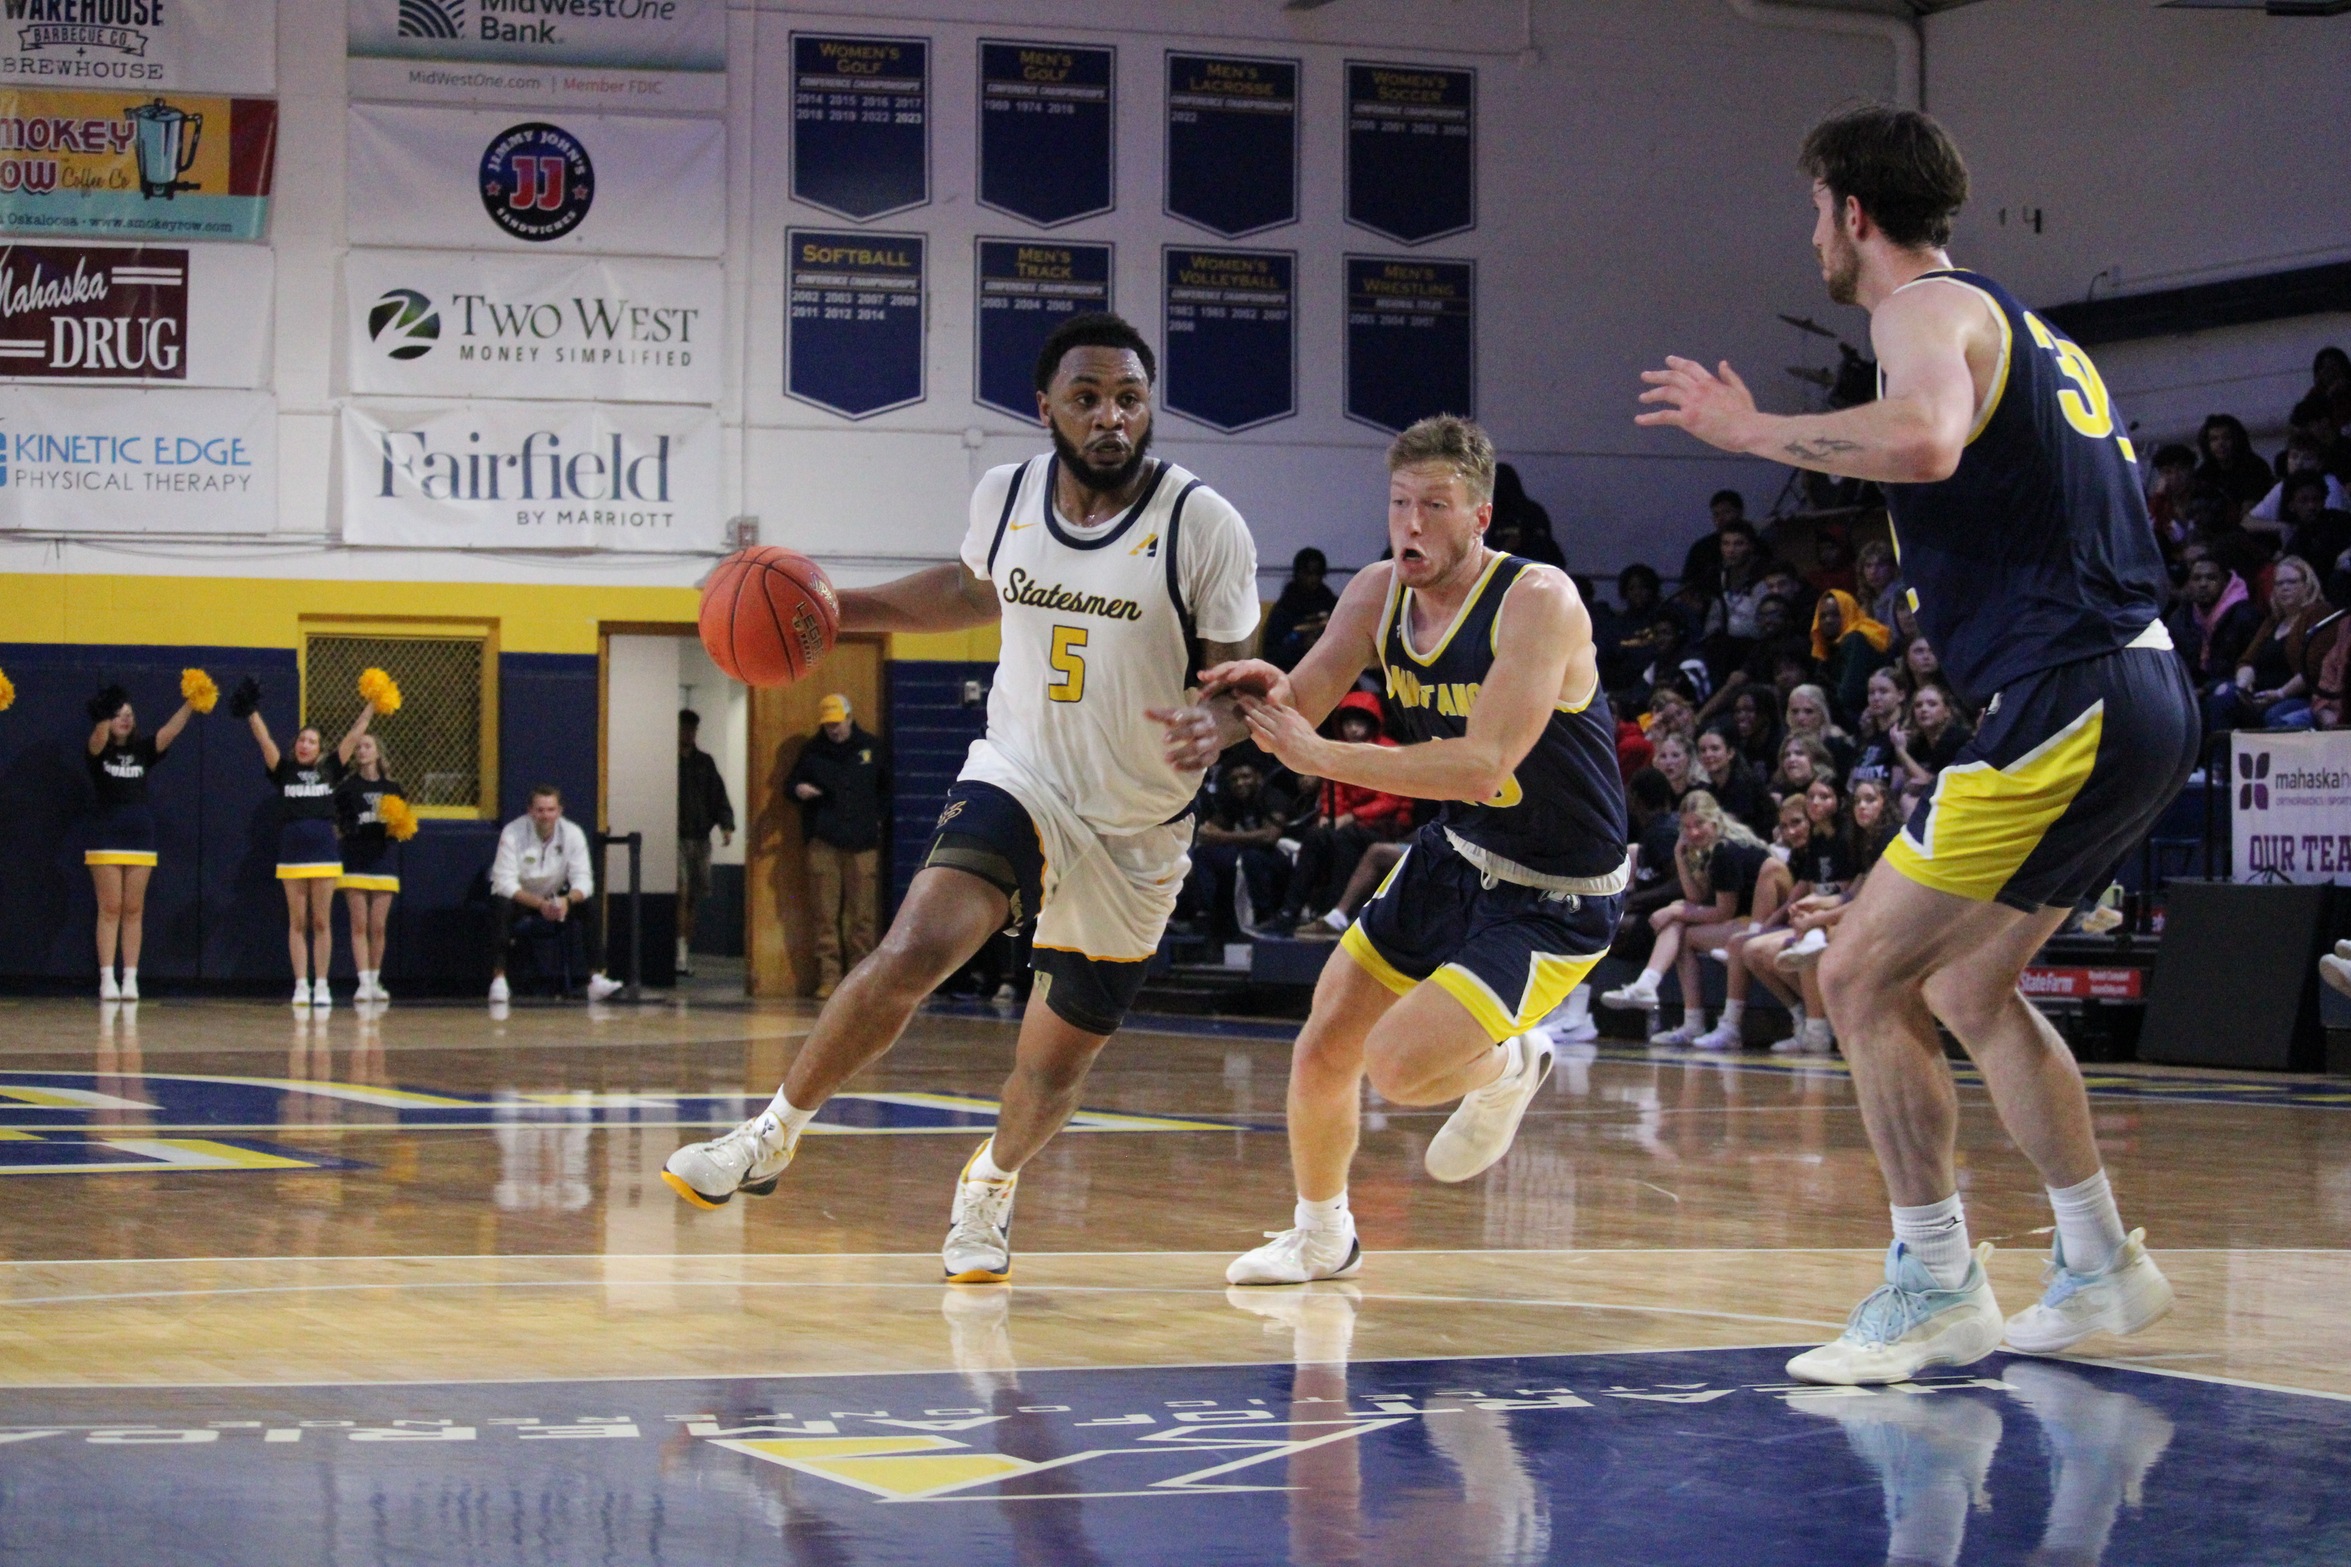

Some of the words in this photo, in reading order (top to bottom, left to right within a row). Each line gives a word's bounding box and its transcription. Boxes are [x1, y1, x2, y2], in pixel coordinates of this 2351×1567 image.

[5, 0, 164, 26] WAREHOUSE
[480, 0, 676, 20] MidWestOne
[34, 27, 104, 44] BARBECUE
[480, 16, 557, 43] Bank
[820, 42, 901, 60] WOMEN'S
[1020, 50, 1073, 67] MEN'S
[2, 57, 164, 80] BREWHOUSE
[836, 59, 883, 74] GOLF
[1023, 66, 1070, 81] GOLF
[409, 70, 541, 90] MidWestOne.com
[563, 79, 624, 94] Member
[628, 80, 663, 95] FDIC
[487, 129, 534, 172] JIMMY
[539, 130, 586, 175] JOHN'S
[62, 169, 103, 197] Coffee
[508, 155, 565, 211] JJ
[8, 213, 79, 227] Oskaloosa
[89, 214, 233, 234] www.smokeyrow.com
[496, 206, 577, 234] SANDWICHES
[803, 244, 912, 267] SOFTBALL
[1017, 247, 1072, 264] MEN'S
[1016, 262, 1073, 278] TRACK
[452, 294, 563, 339] TWO
[572, 298, 698, 343] WEST
[49, 316, 180, 371] DRUG
[460, 344, 538, 361] MONEY
[556, 347, 692, 366] SIMPLIFIED
[16, 433, 143, 464] KINETIC
[155, 437, 251, 466] EDGE
[377, 430, 674, 503] Fairfield
[16, 469, 134, 491] PHYSICAL
[145, 472, 251, 492] THERAPY
[517, 511, 545, 525] BY
[557, 511, 674, 527] MARRIOTT
[1003, 567, 1142, 621] Statesmen
[1048, 624, 1089, 704] 5
[2250, 835, 2296, 872] OUR
